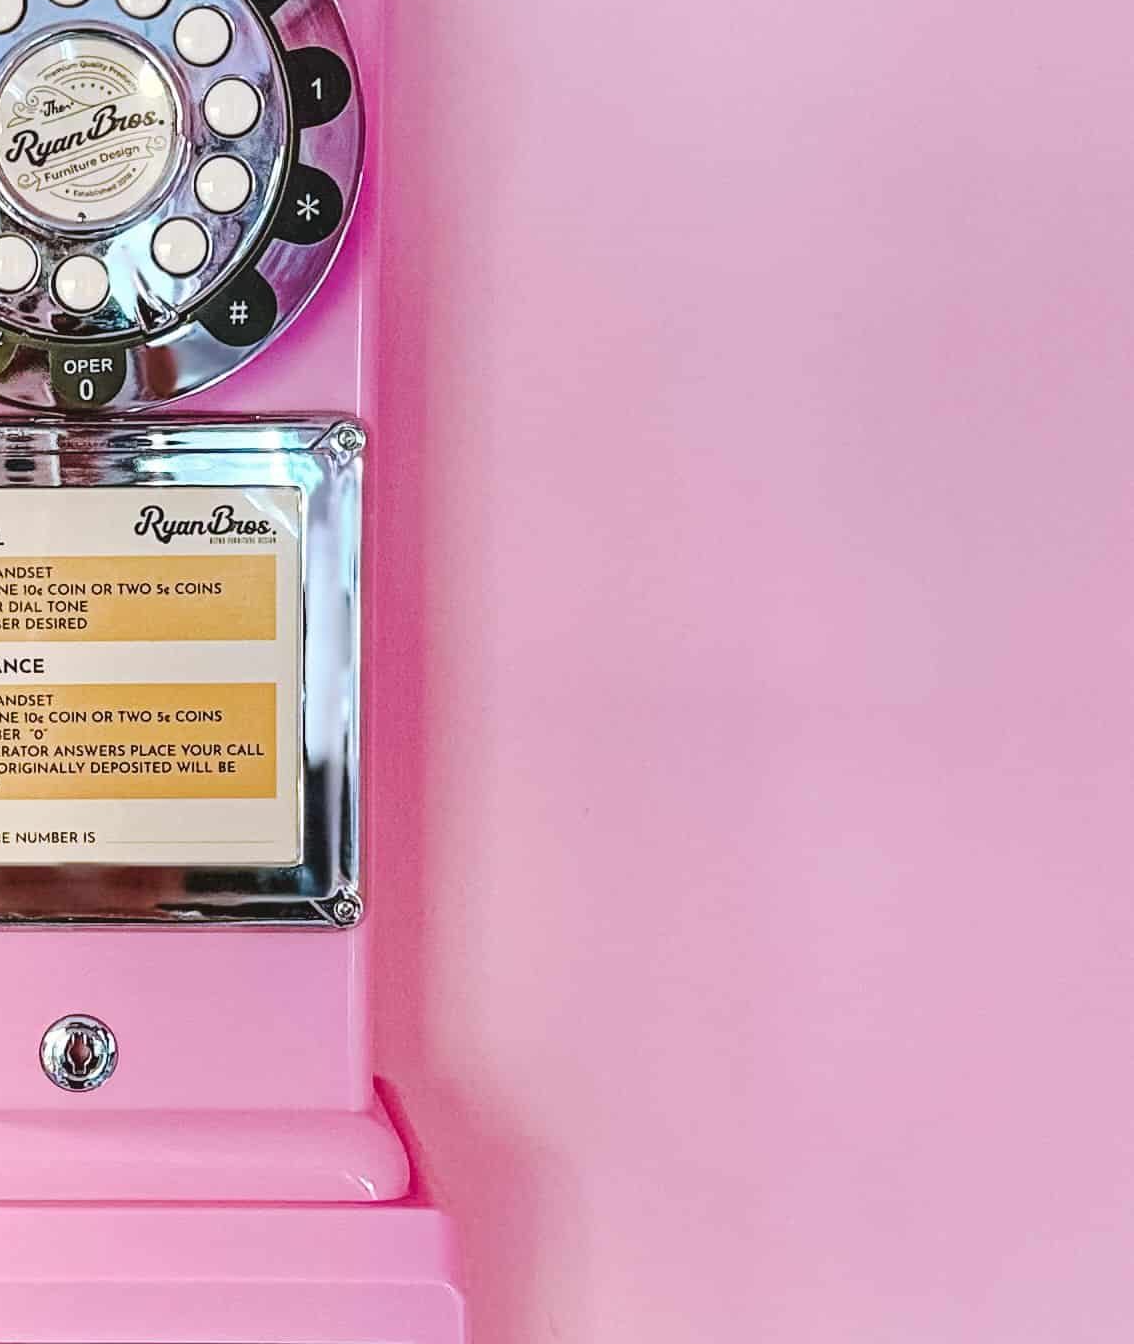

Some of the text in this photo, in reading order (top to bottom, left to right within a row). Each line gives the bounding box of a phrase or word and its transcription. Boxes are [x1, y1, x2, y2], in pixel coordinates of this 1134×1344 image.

[311, 77, 322, 100] 1
[5, 104, 165, 167] Ryan Bros.
[43, 144, 141, 184] Furniture Design
[63, 358, 113, 375] OPER
[79, 378, 94, 401] 0
[134, 504, 278, 545] Ryan Bros.
[23, 584, 43, 596] 10¢
[47, 583, 86, 596] COIN
[91, 583, 113, 596] OR
[116, 582, 152, 595] TWO
[156, 583, 170, 596] 5¢
[174, 582, 222, 595] COINS
[8, 600, 43, 613] DIAL
[46, 600, 89, 613] TONE
[25, 617, 88, 630] DESIRED
[24, 711, 44, 724] 10¢
[48, 711, 87, 724] COIN
[91, 710, 114, 724] OR
[117, 710, 152, 723] TWO
[157, 711, 171, 723] 5¢
[175, 709, 223, 723] COINS
[53, 744, 126, 757] ANSWERS
[130, 743, 177, 757] PLACE
[180, 743, 222, 757] YOUR
[226, 743, 265, 757] CALL
[90, 761, 173, 774] DEPOSITED
[176, 760, 214, 774] WILL
[218, 760, 237, 774] BE
[15, 831, 78, 844] NUMBER
[83, 831, 96, 844] IS
